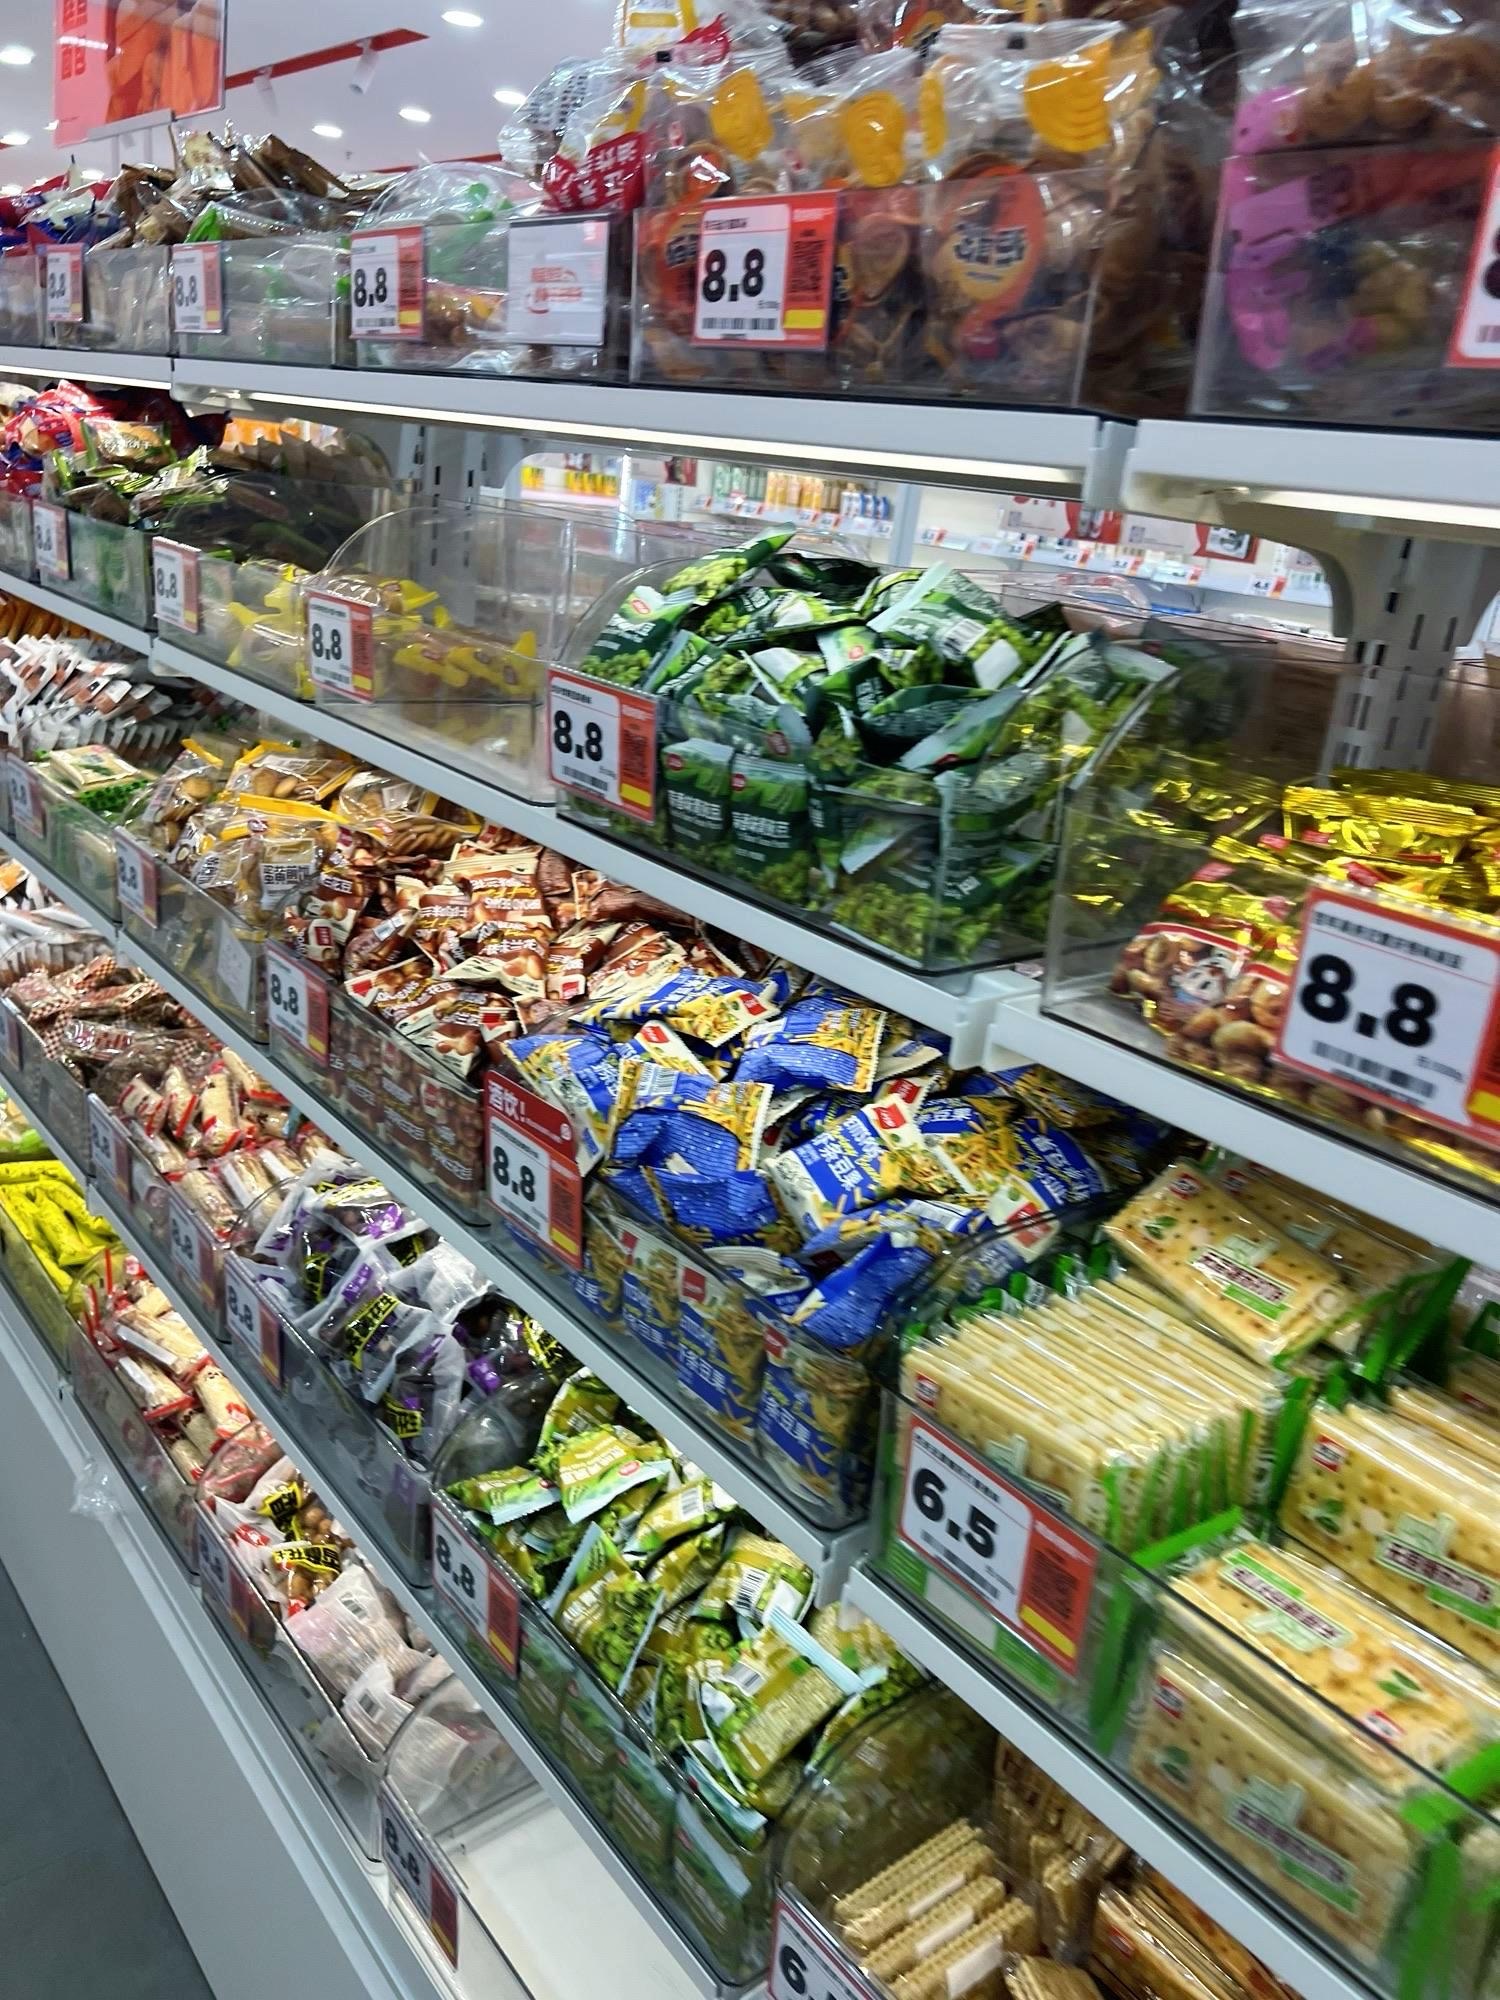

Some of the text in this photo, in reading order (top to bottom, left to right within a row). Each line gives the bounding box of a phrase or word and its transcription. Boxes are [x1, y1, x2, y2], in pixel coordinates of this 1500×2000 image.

[353, 267, 388, 308] 8.8
[702, 248, 765, 303] 8.8
[156, 567, 178, 599] 8.8
[311, 622, 343, 662] 8.8
[553, 710, 603, 763] 8.8
[271, 975, 300, 1017] 8.8
[1300, 953, 1438, 1049] 8.8
[493, 1145, 536, 1203] 8.8
[228, 1283, 254, 1333] 8.8
[911, 1467, 998, 1559] 6.5
[435, 1530, 476, 1599] 8.8
[384, 1816, 420, 1887] 8.8
